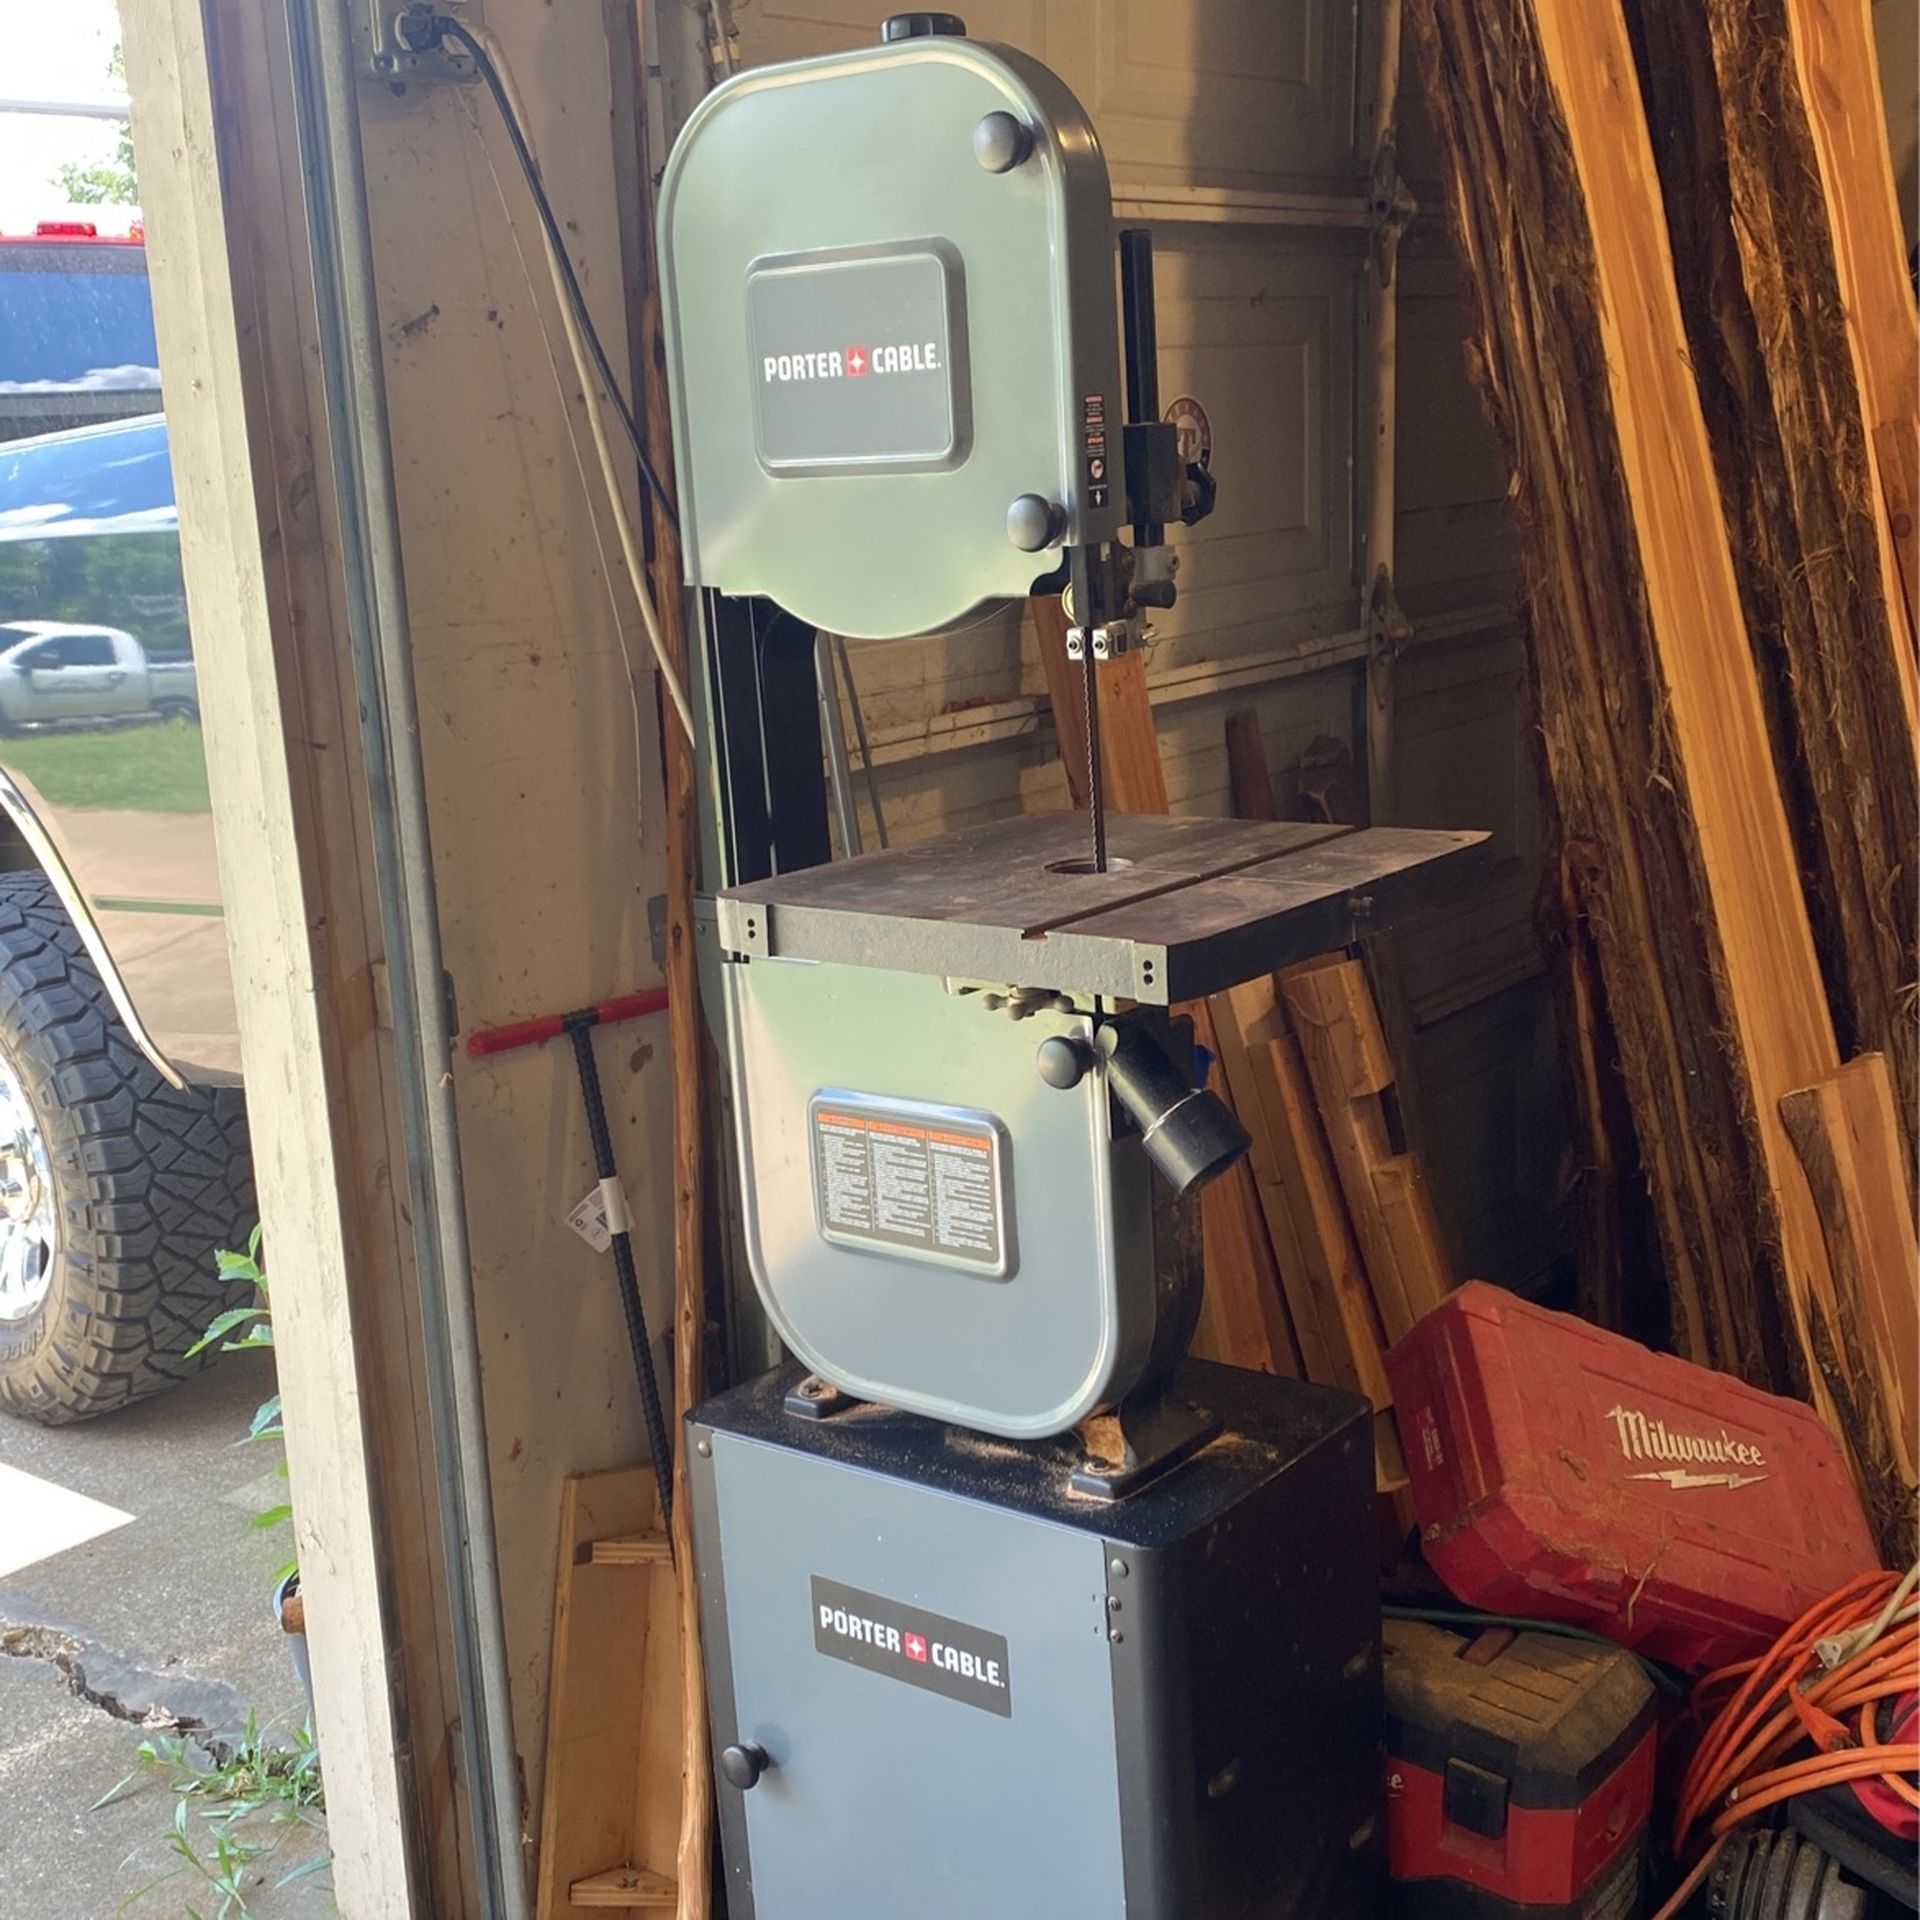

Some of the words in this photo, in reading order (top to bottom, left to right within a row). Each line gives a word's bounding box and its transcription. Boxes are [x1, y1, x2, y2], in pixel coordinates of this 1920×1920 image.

[764, 352, 843, 382] PORTER
[1604, 1405, 1766, 1466] Milwaukee
[819, 1605, 901, 1654] PORTER
